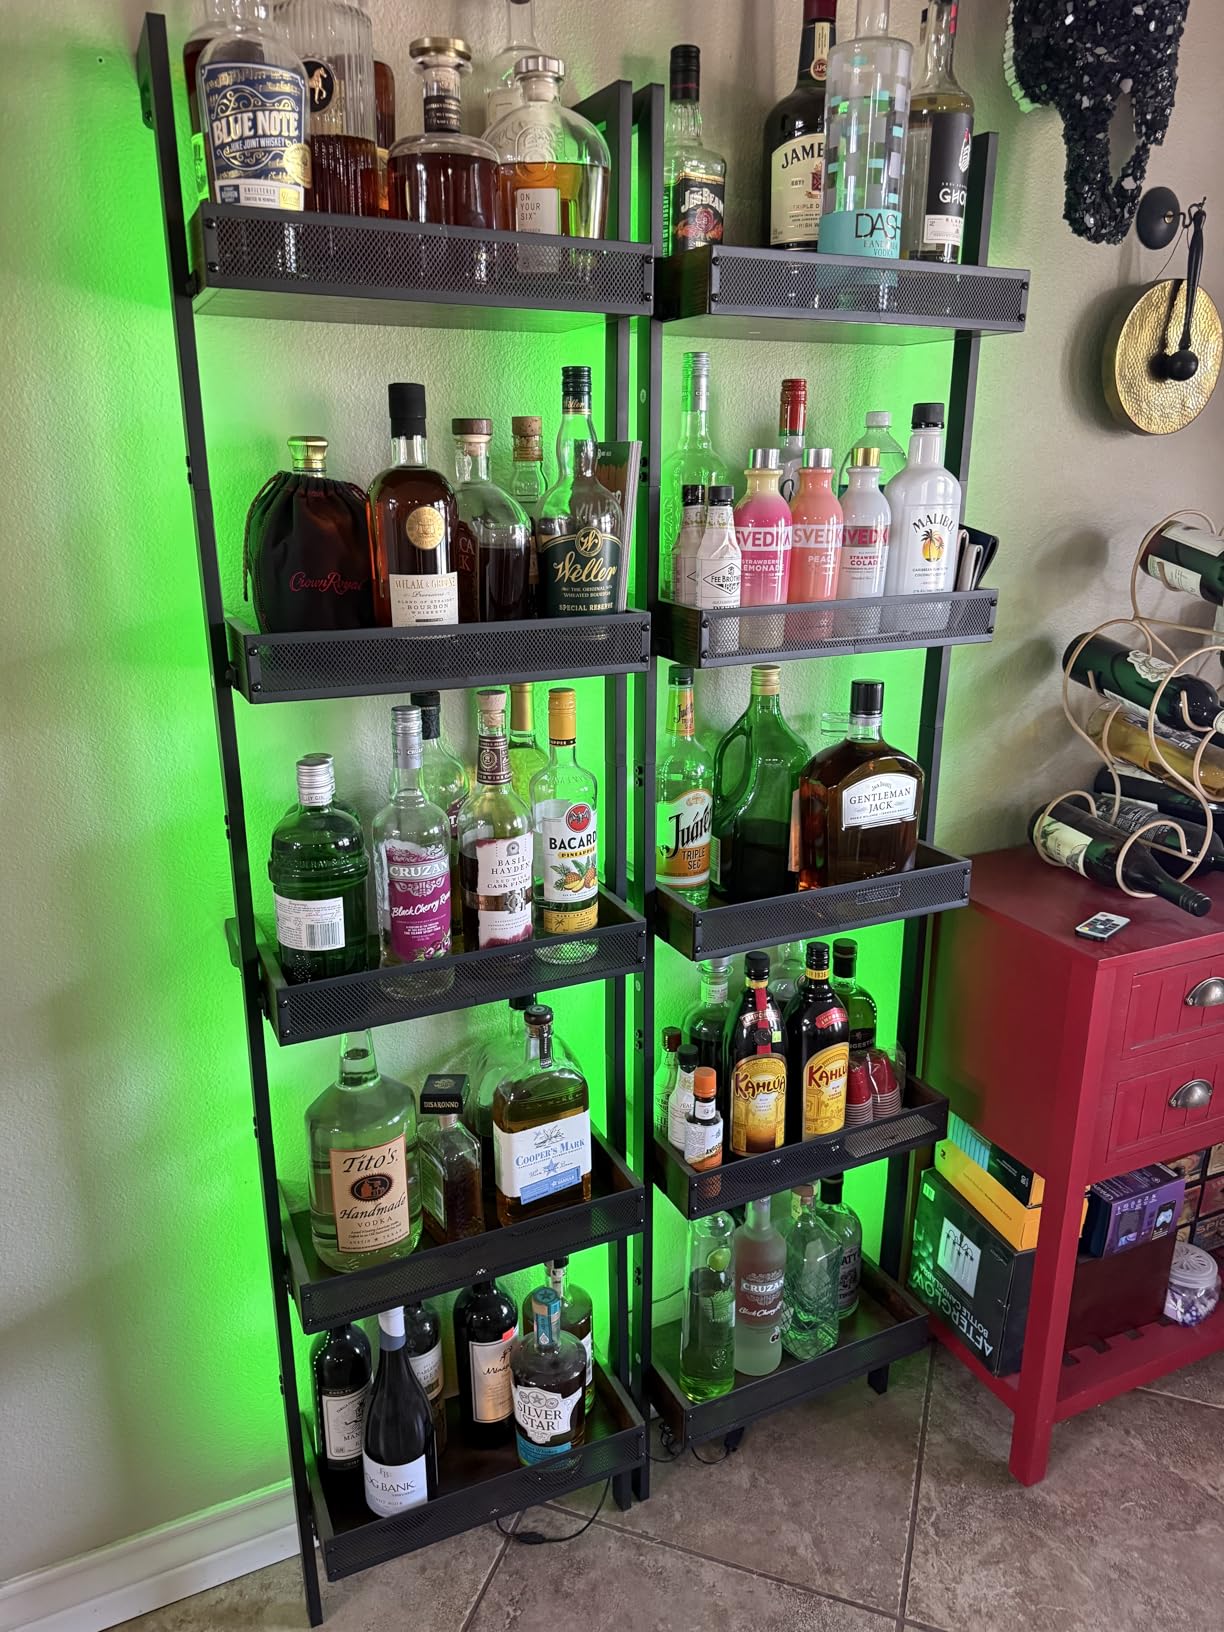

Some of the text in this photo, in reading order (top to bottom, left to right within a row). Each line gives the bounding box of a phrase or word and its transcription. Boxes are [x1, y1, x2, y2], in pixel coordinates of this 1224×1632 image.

[212, 111, 300, 145] BLUE NOTE
[243, 139, 259, 151] JOINT
[260, 138, 285, 149] WHISKEY
[520, 193, 530, 201] ON
[520, 203, 541, 211] YOUR
[912, 513, 955, 533] MALIBU
[552, 550, 618, 583] Weller
[289, 571, 362, 595] Crown Royal
[711, 575, 721, 583] FEE
[407, 603, 449, 611] BOURBON
[559, 604, 588, 612] SPECIAL
[849, 787, 911, 805] GENTLEMAN
[868, 800, 893, 814] JACK
[498, 856, 527, 868] BASIL
[682, 848, 705, 861] TRIPLE
[389, 861, 450, 879] CRUZAN
[687, 860, 702, 870] SEC
[391, 905, 416, 919] Black
[414, 899, 440, 915] Cherry
[735, 1072, 786, 1100] KAHLÚA
[423, 1101, 460, 1109] DISARONNO
[343, 1148, 396, 1174] Tito's
[515, 1139, 586, 1167] COOPER'S MARK
[339, 1192, 406, 1220] Handmade
[357, 1216, 393, 1229] VODKA
[912, 1270, 994, 1357] AFTERGLOW
[962, 1306, 989, 1339] BOTTLE
[517, 1400, 562, 1420] SILVER
[522, 1413, 557, 1431] STAR
[381, 1480, 416, 1493] BANK
